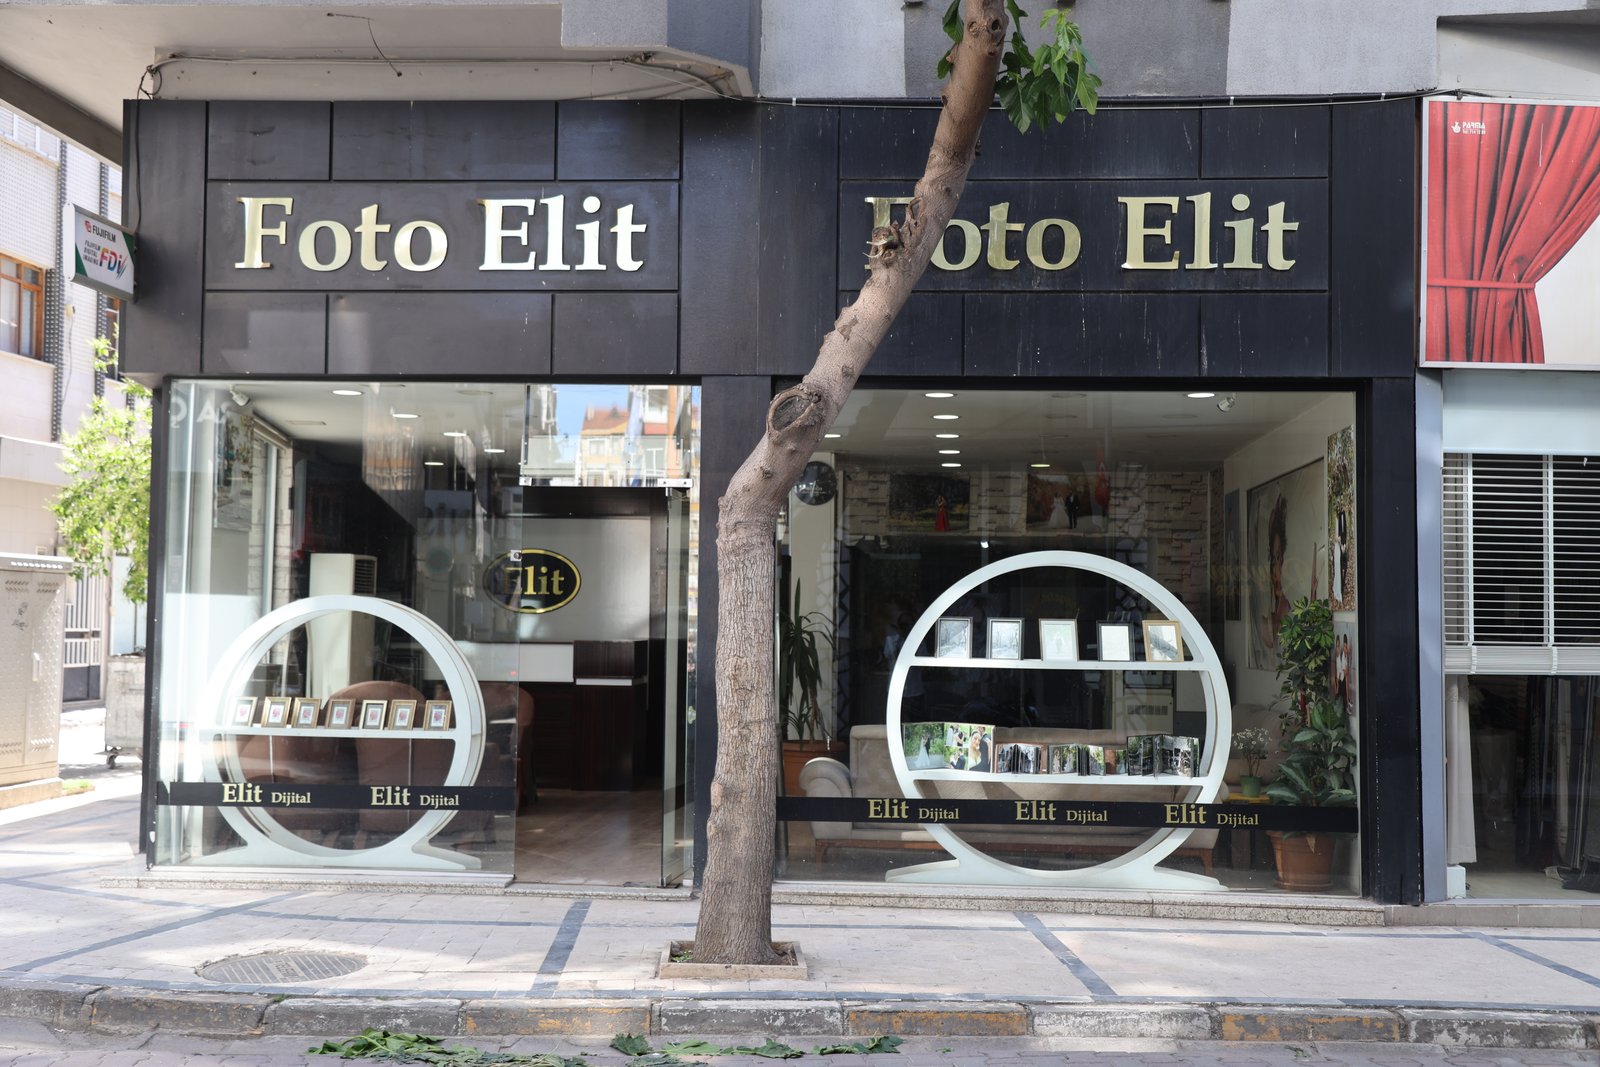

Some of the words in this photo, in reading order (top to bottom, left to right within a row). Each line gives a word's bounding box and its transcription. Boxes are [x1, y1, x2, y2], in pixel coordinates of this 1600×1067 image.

[93, 225, 116, 243] FUJIFILM
[234, 196, 448, 272] Foto
[476, 194, 647, 272] Elit
[1117, 191, 1300, 271] Elit
[222, 783, 263, 804] Elit
[271, 792, 312, 807] Dijital
[370, 786, 412, 806] Elit
[419, 794, 460, 810] Dijital
[867, 798, 910, 819] Elit
[918, 808, 960, 823] Dijital
[1014, 800, 1057, 821] Elit
[1066, 809, 1109, 825] Dijital
[1164, 803, 1207, 824] Elit
[1216, 813, 1259, 828] Dijital
